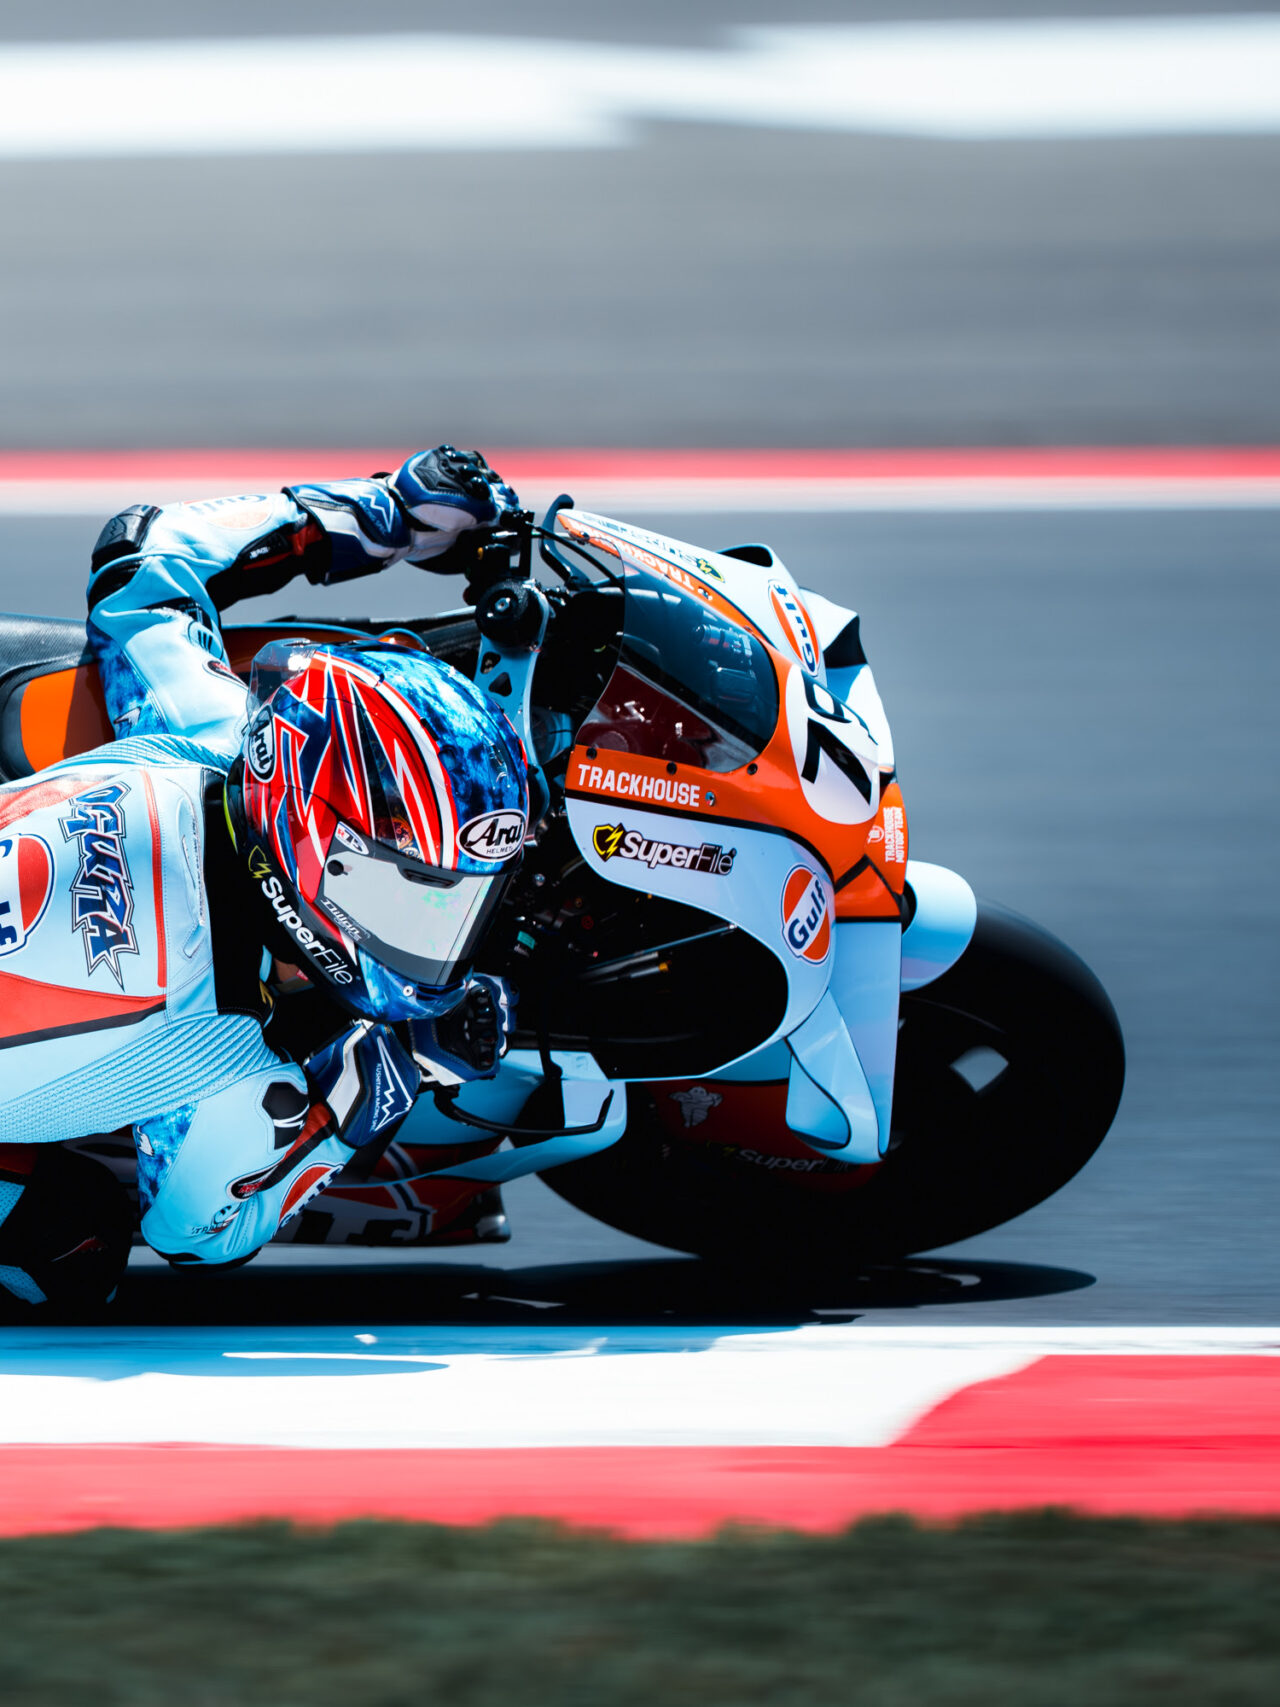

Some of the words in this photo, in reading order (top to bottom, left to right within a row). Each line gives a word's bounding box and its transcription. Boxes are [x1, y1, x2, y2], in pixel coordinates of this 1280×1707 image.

[773, 584, 816, 673] Gulf
[577, 763, 701, 808] TRACKHOUSE
[61, 782, 138, 978] OGURA
[619, 830, 734, 876] SuperFile
[261, 875, 353, 985] SuperFile
[787, 879, 826, 950] Gulf
